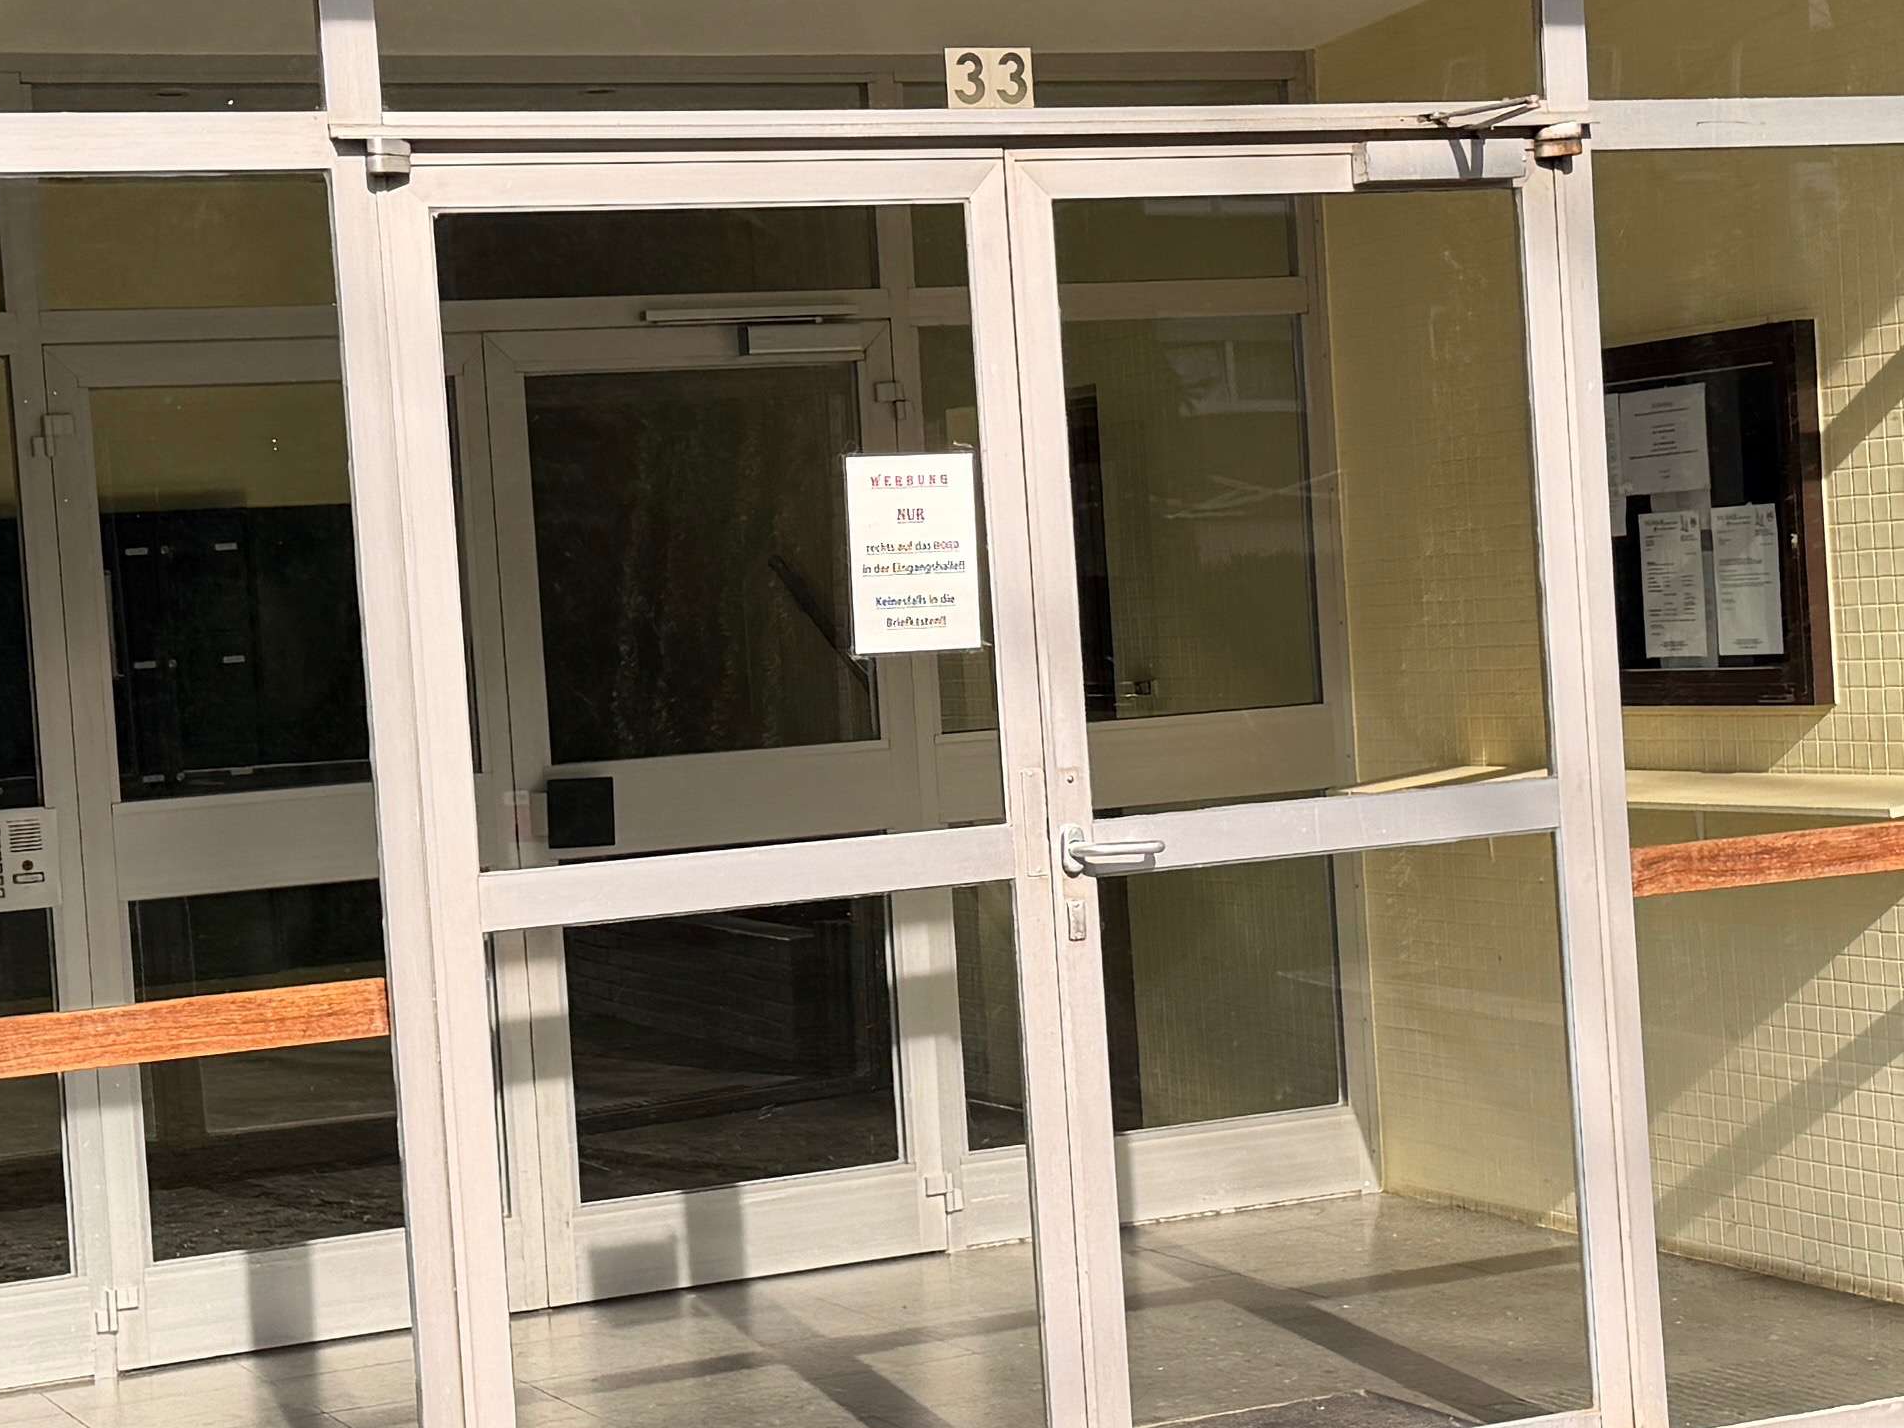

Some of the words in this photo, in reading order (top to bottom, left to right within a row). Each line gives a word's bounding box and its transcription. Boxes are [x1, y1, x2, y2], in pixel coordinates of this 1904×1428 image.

[954, 52, 1028, 105] 33
[897, 508, 925, 521] NUR
[866, 542, 895, 553] rechts
[915, 540, 931, 551] das
[862, 563, 872, 574] in
[874, 563, 890, 574] der
[929, 594, 938, 604] in
[940, 593, 955, 604] die
